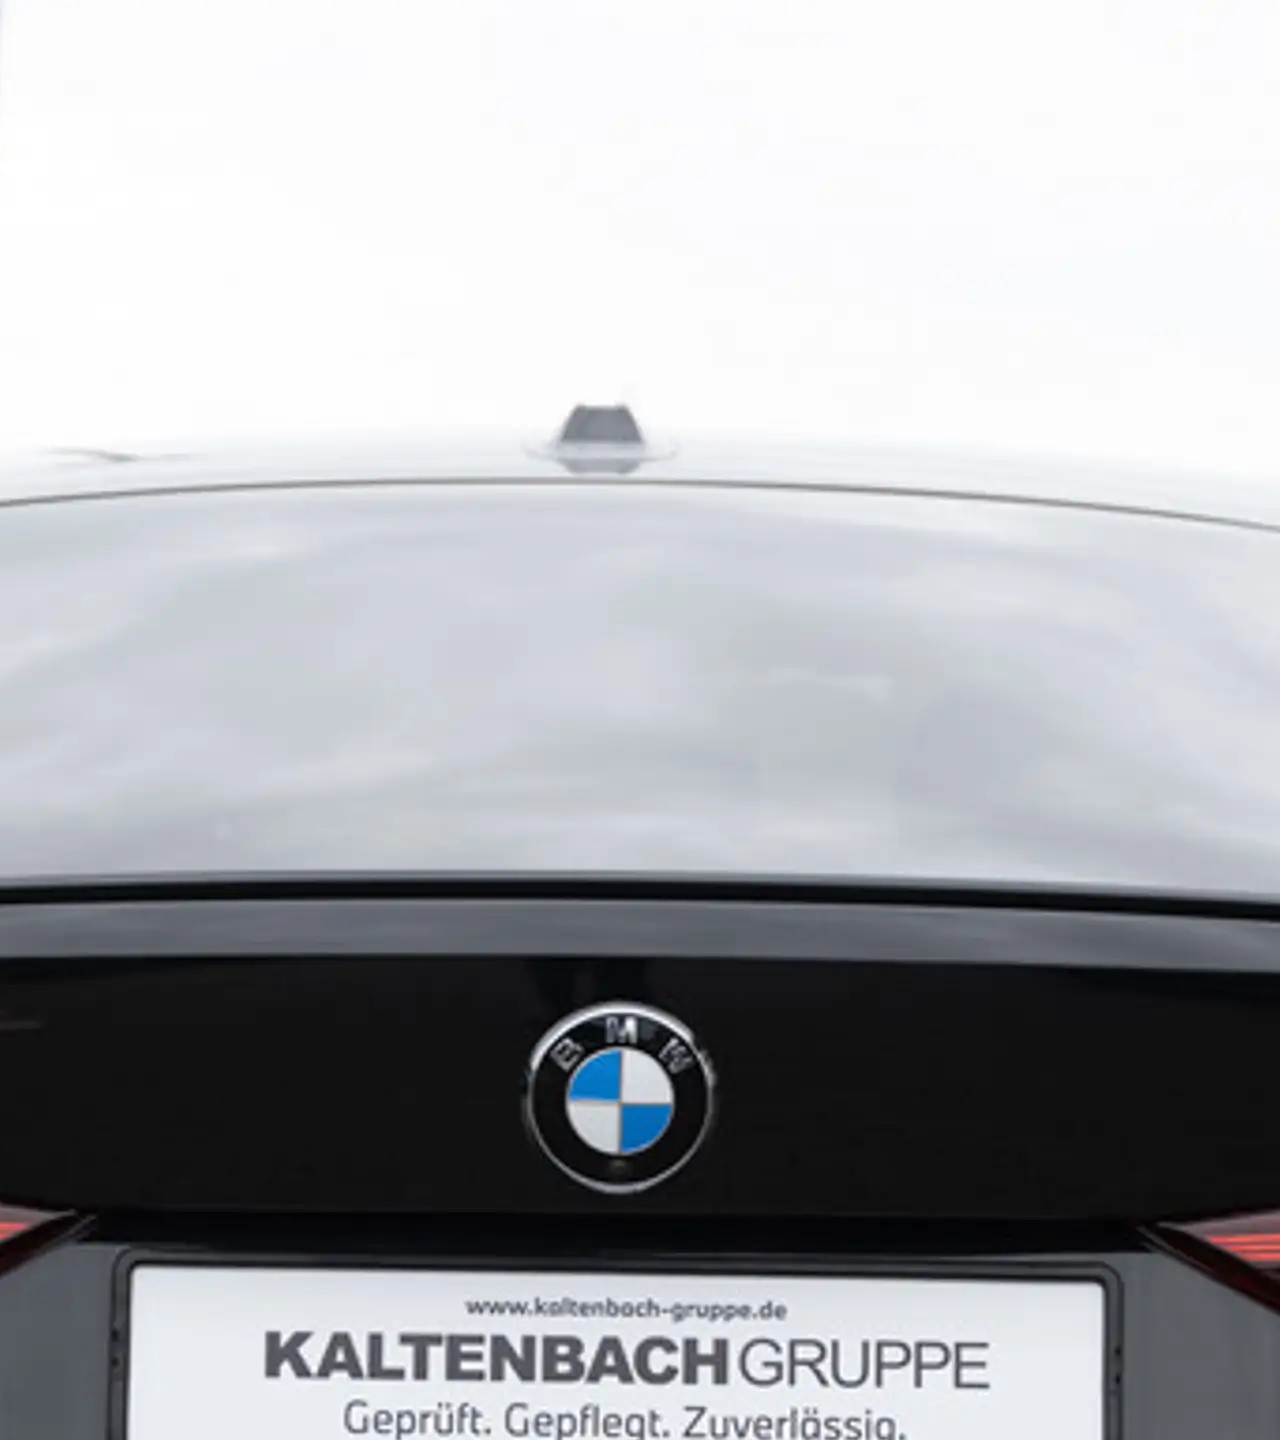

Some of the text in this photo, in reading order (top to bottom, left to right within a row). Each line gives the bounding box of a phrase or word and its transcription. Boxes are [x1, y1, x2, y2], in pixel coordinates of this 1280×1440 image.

[550, 1015, 694, 1074] BMW
[465, 1296, 788, 1323] www.kaltenbach-gruppe.de
[342, 1399, 492, 1440] Geprüft.
